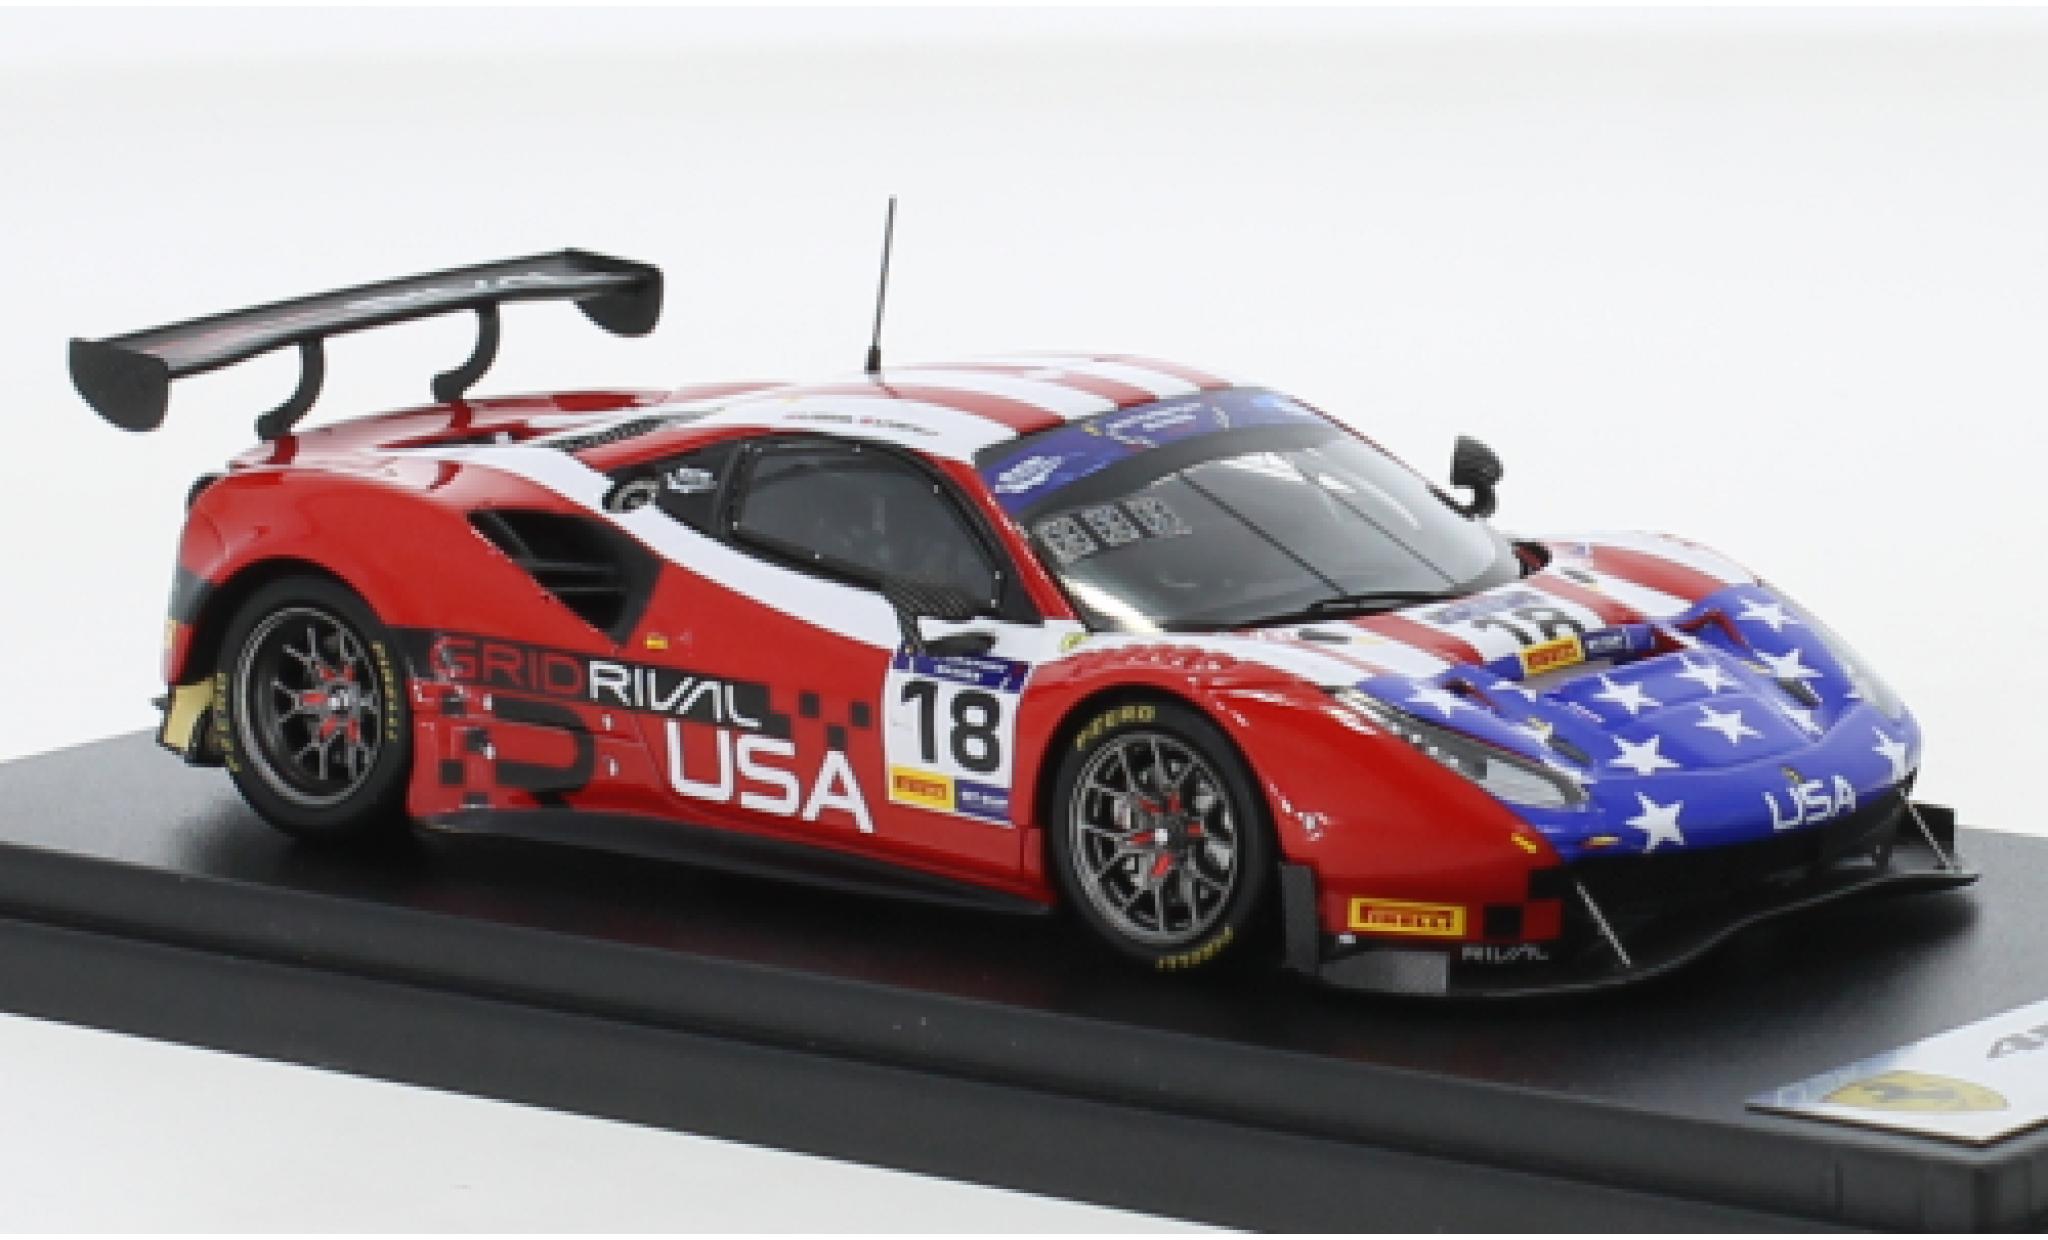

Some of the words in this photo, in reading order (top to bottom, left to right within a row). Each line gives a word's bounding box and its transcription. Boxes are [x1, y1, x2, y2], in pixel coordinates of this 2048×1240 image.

[430, 634, 584, 694] GRID
[588, 659, 762, 729] RIVAL
[900, 680, 1001, 775] 18
[666, 719, 874, 834] USA
[1761, 774, 1858, 833] USA
[1359, 902, 1456, 933] PIRELLI
